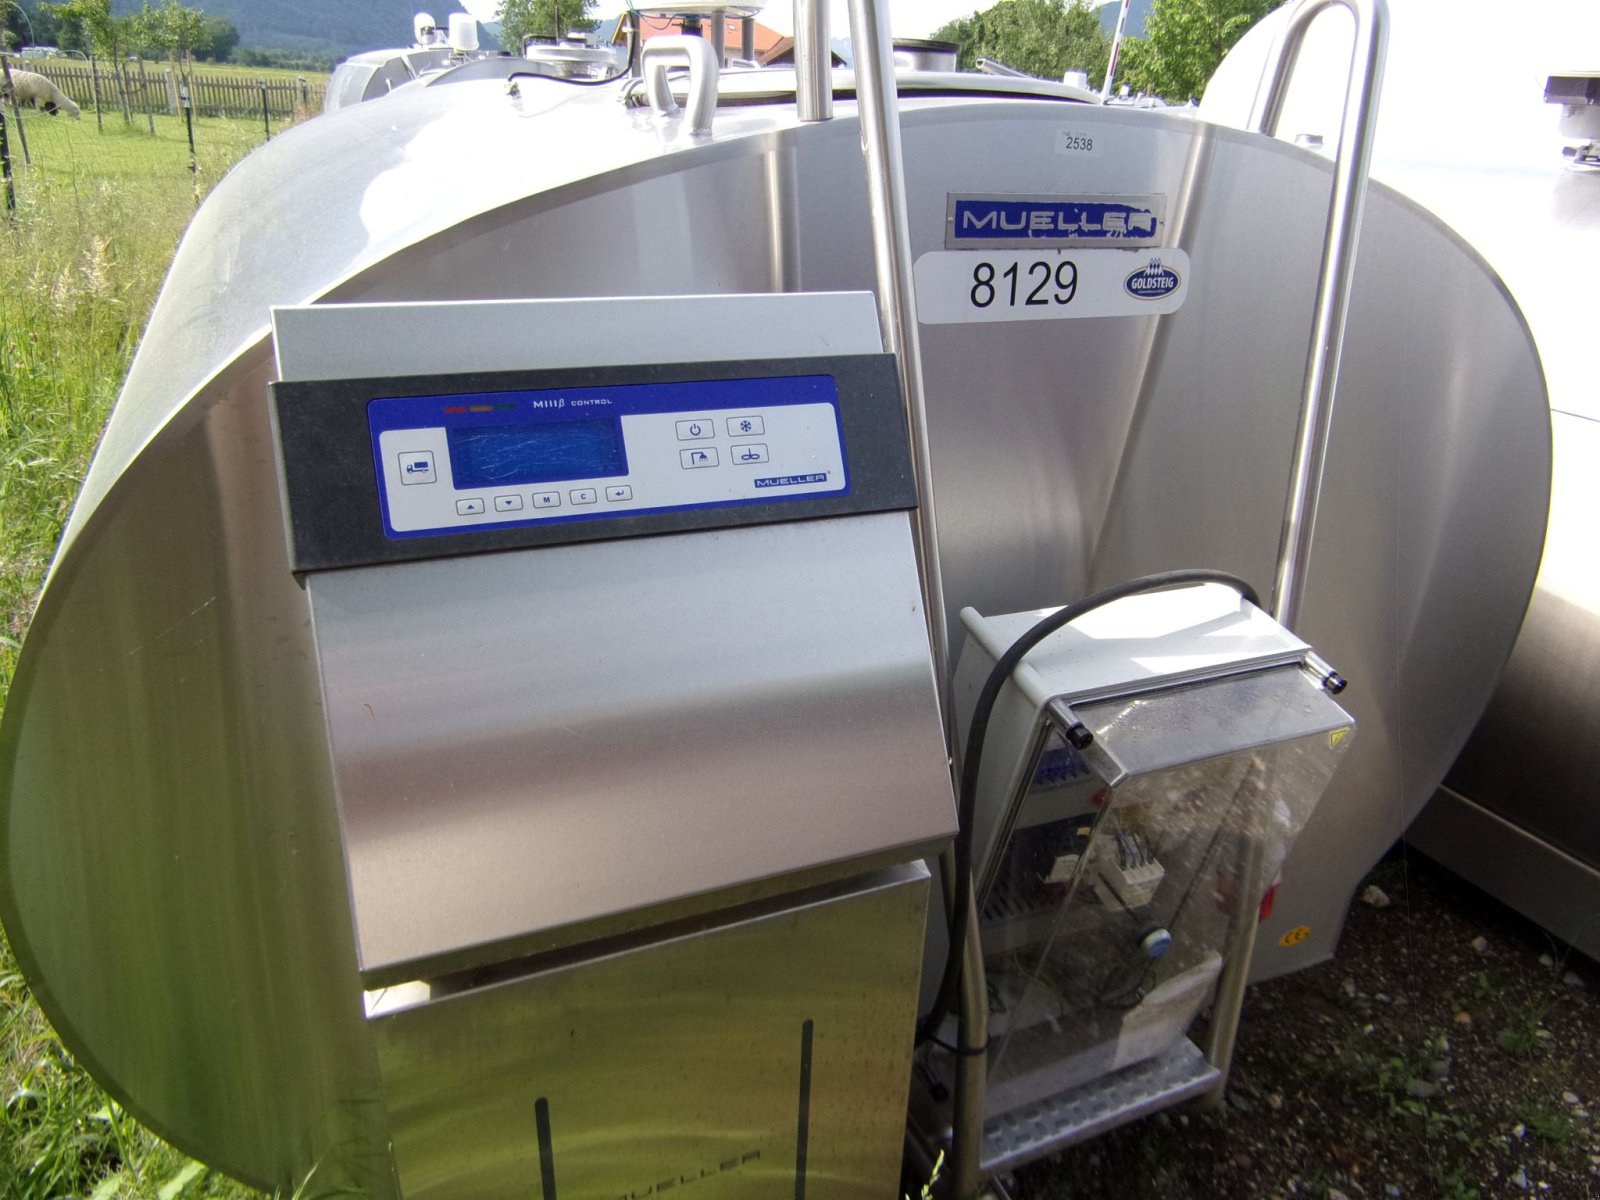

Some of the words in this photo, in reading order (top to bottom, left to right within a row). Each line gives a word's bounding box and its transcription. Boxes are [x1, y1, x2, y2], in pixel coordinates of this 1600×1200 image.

[1065, 136, 1093, 151] 2538
[962, 210, 1152, 231] MUELLER
[970, 260, 1079, 308] 8129
[1131, 276, 1174, 289] GOLDSTEIG
[571, 398, 613, 406] CONTROL
[756, 474, 825, 487] MUELLER
